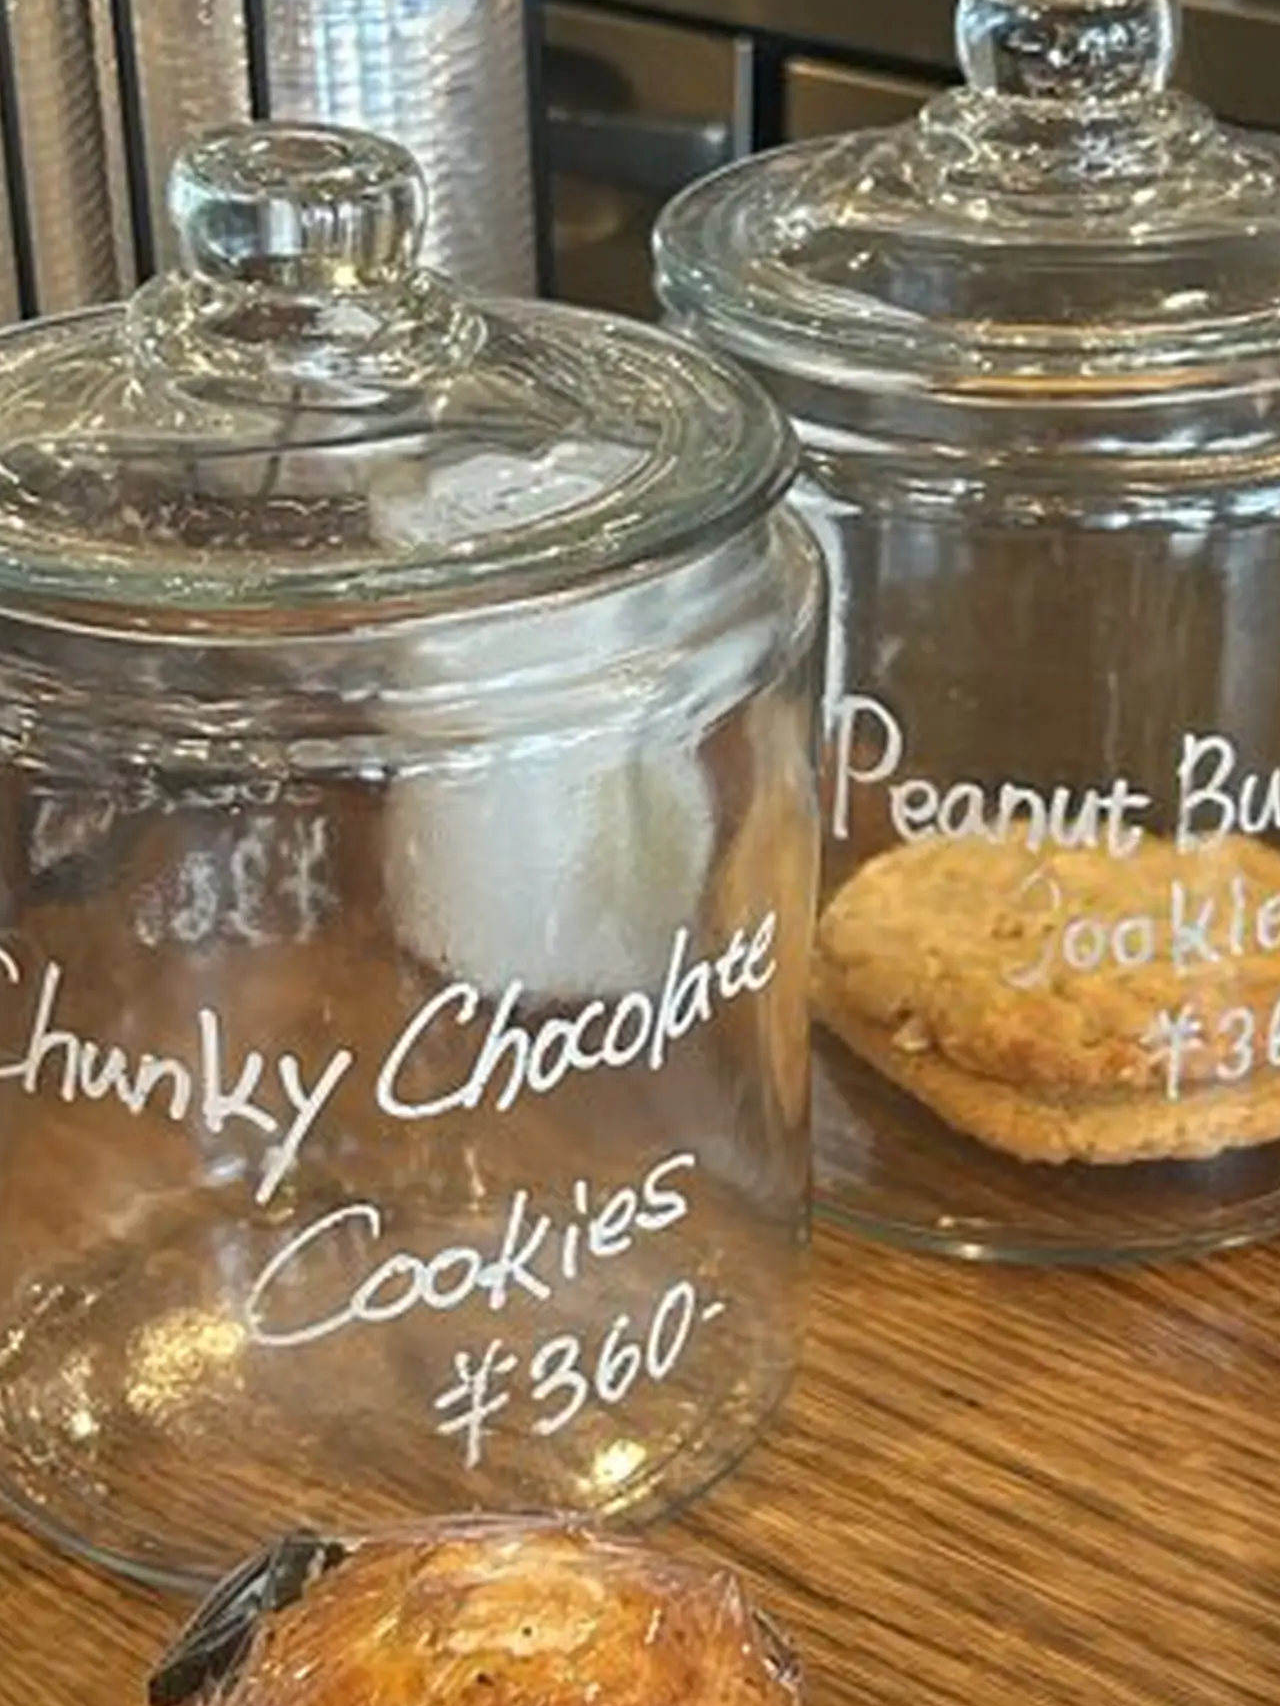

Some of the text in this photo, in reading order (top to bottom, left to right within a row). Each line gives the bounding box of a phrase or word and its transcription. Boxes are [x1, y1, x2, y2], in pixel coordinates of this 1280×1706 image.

[831, 693, 1152, 859] Peanut
[376, 910, 777, 1119] Chocolate
[245, 1154, 695, 1346] Cookies
